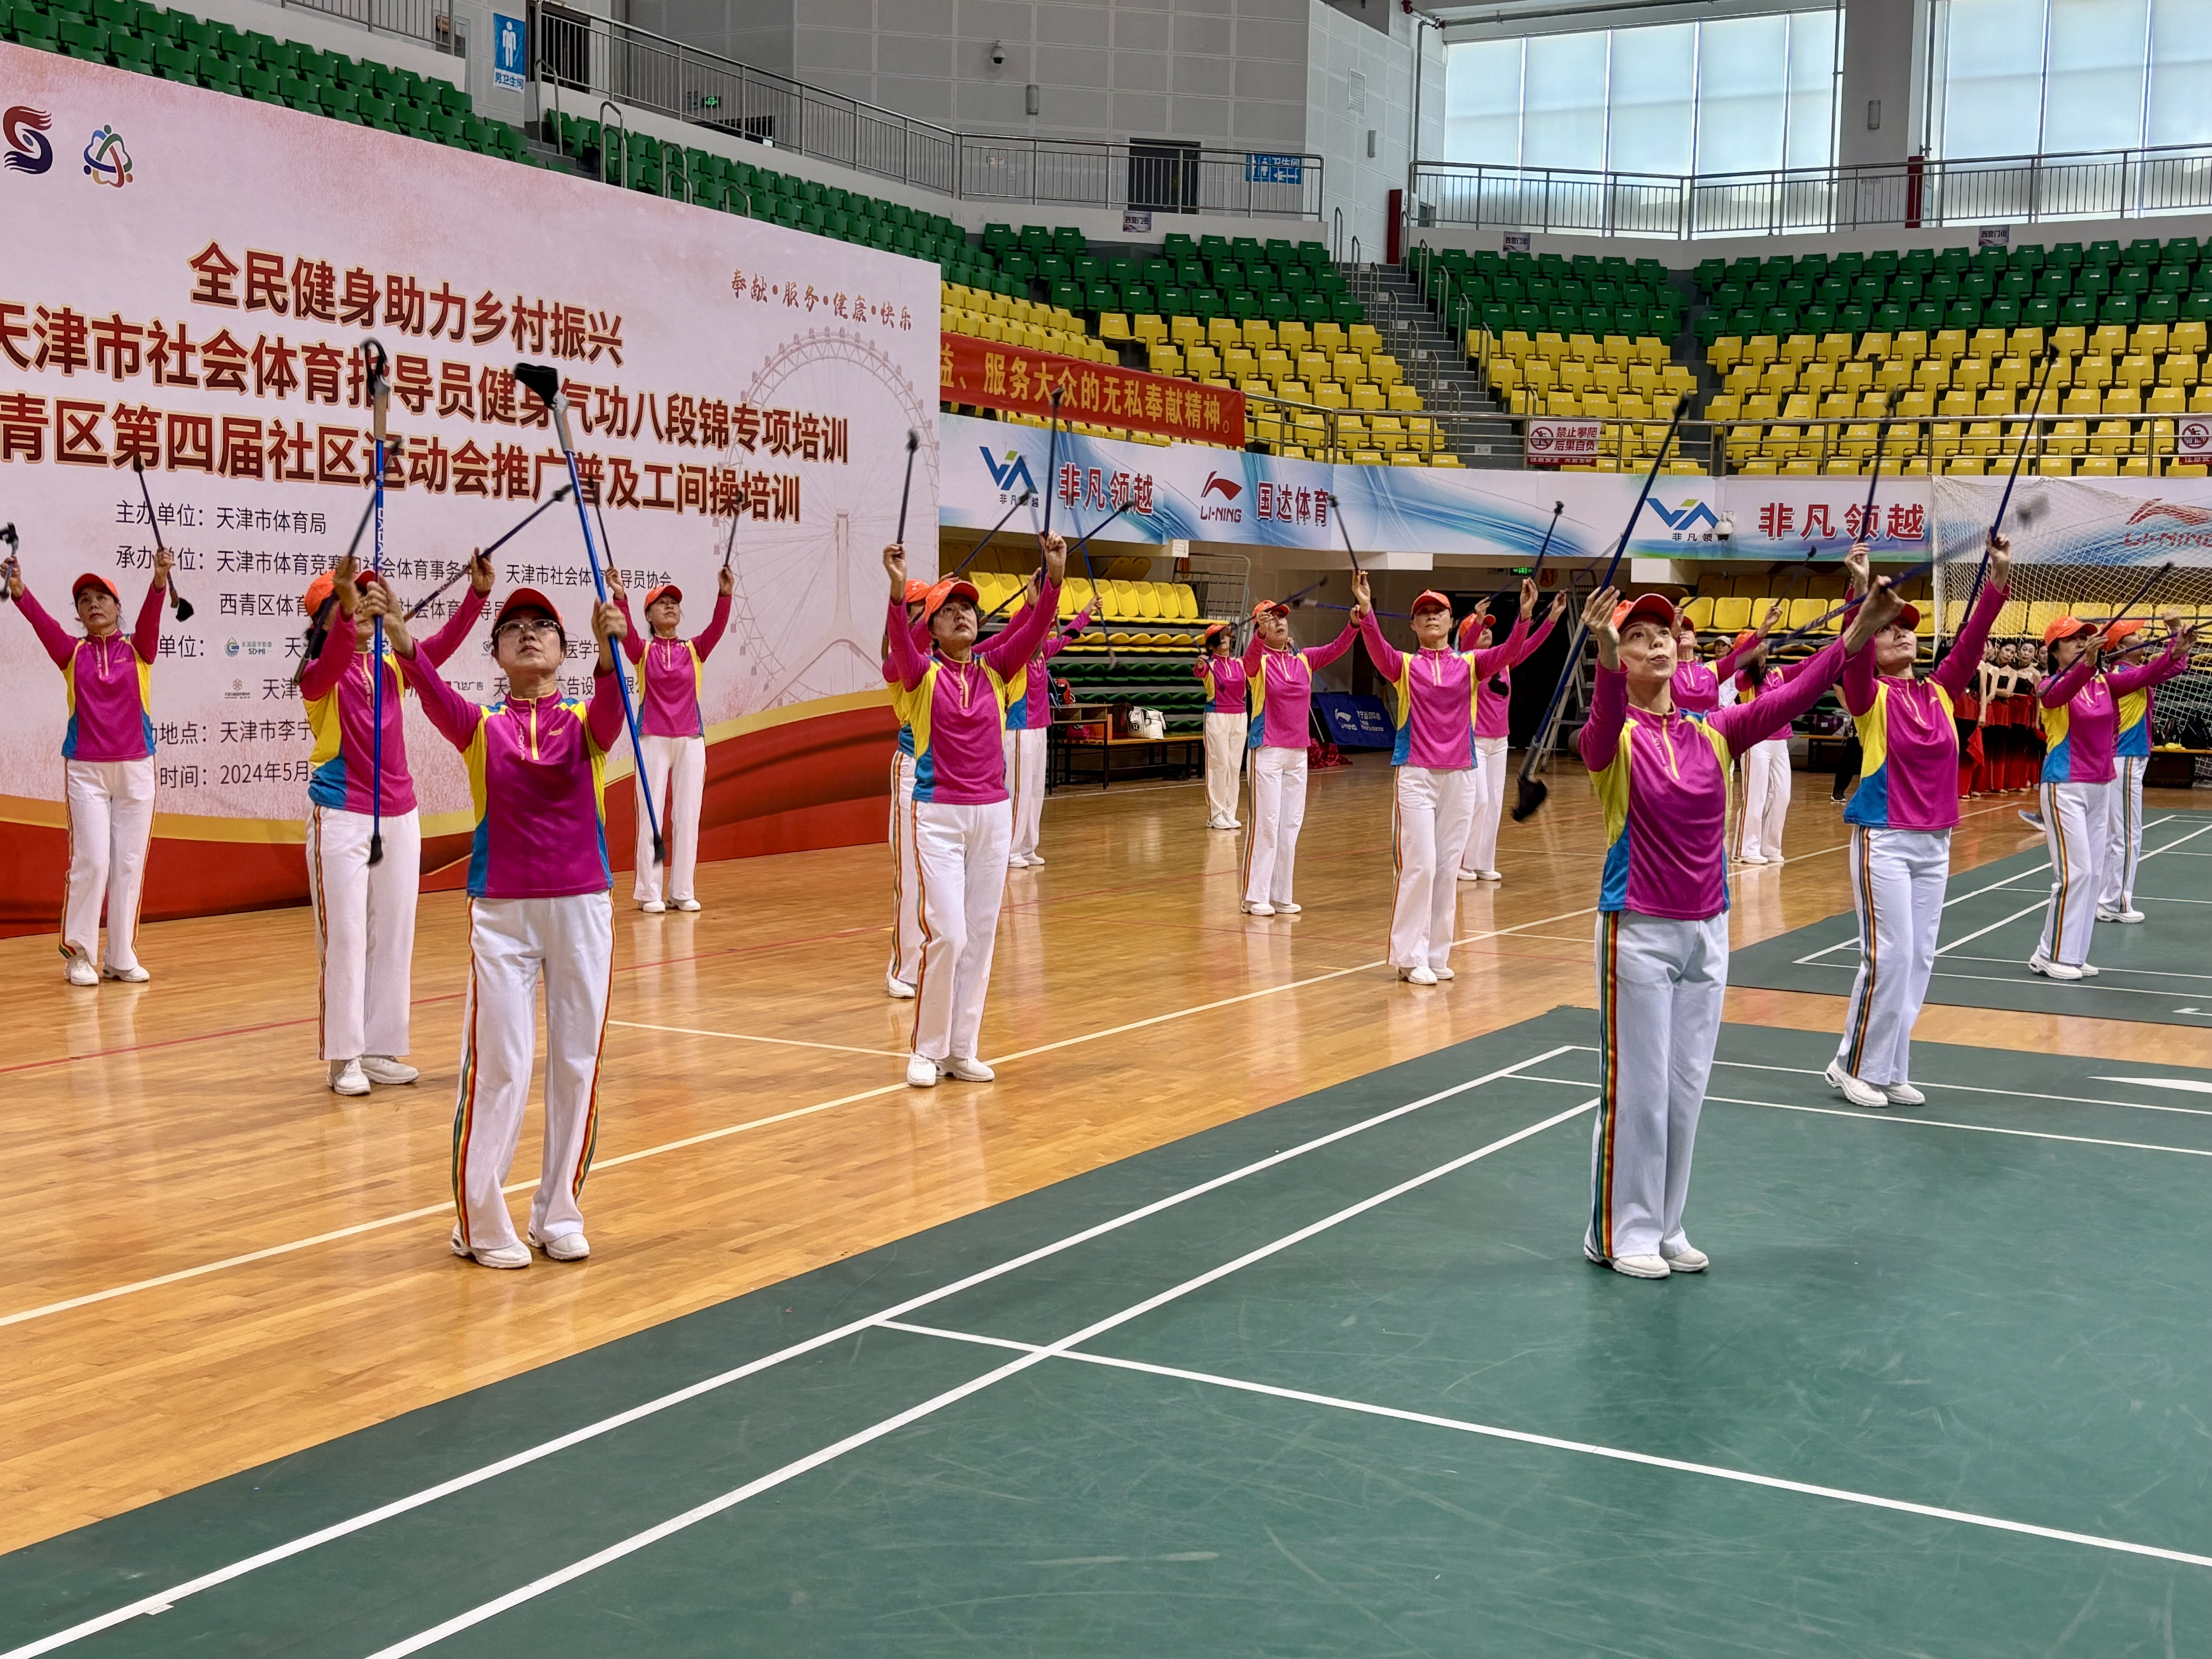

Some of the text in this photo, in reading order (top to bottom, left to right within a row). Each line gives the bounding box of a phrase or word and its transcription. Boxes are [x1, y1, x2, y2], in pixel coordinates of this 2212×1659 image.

[495, 72, 524, 89] 男卫生间
[1272, 157, 1300, 167] 卫生间
[189, 240, 622, 366] 全民健身助力乡村振兴
[1556, 426, 1597, 438] 禁止攀爬
[1554, 440, 1595, 451] 后果自负
[0, 393, 800, 523] 青区第四届社区运动会推广普及工间操培训
[1058, 462, 1154, 515] 非凡领越
[1000, 494, 1039, 508] 非凡越
[1257, 481, 1329, 526] 国达体育
[1200, 505, 1242, 523] LI-NING
[1758, 502, 1924, 540] 非凡领越
